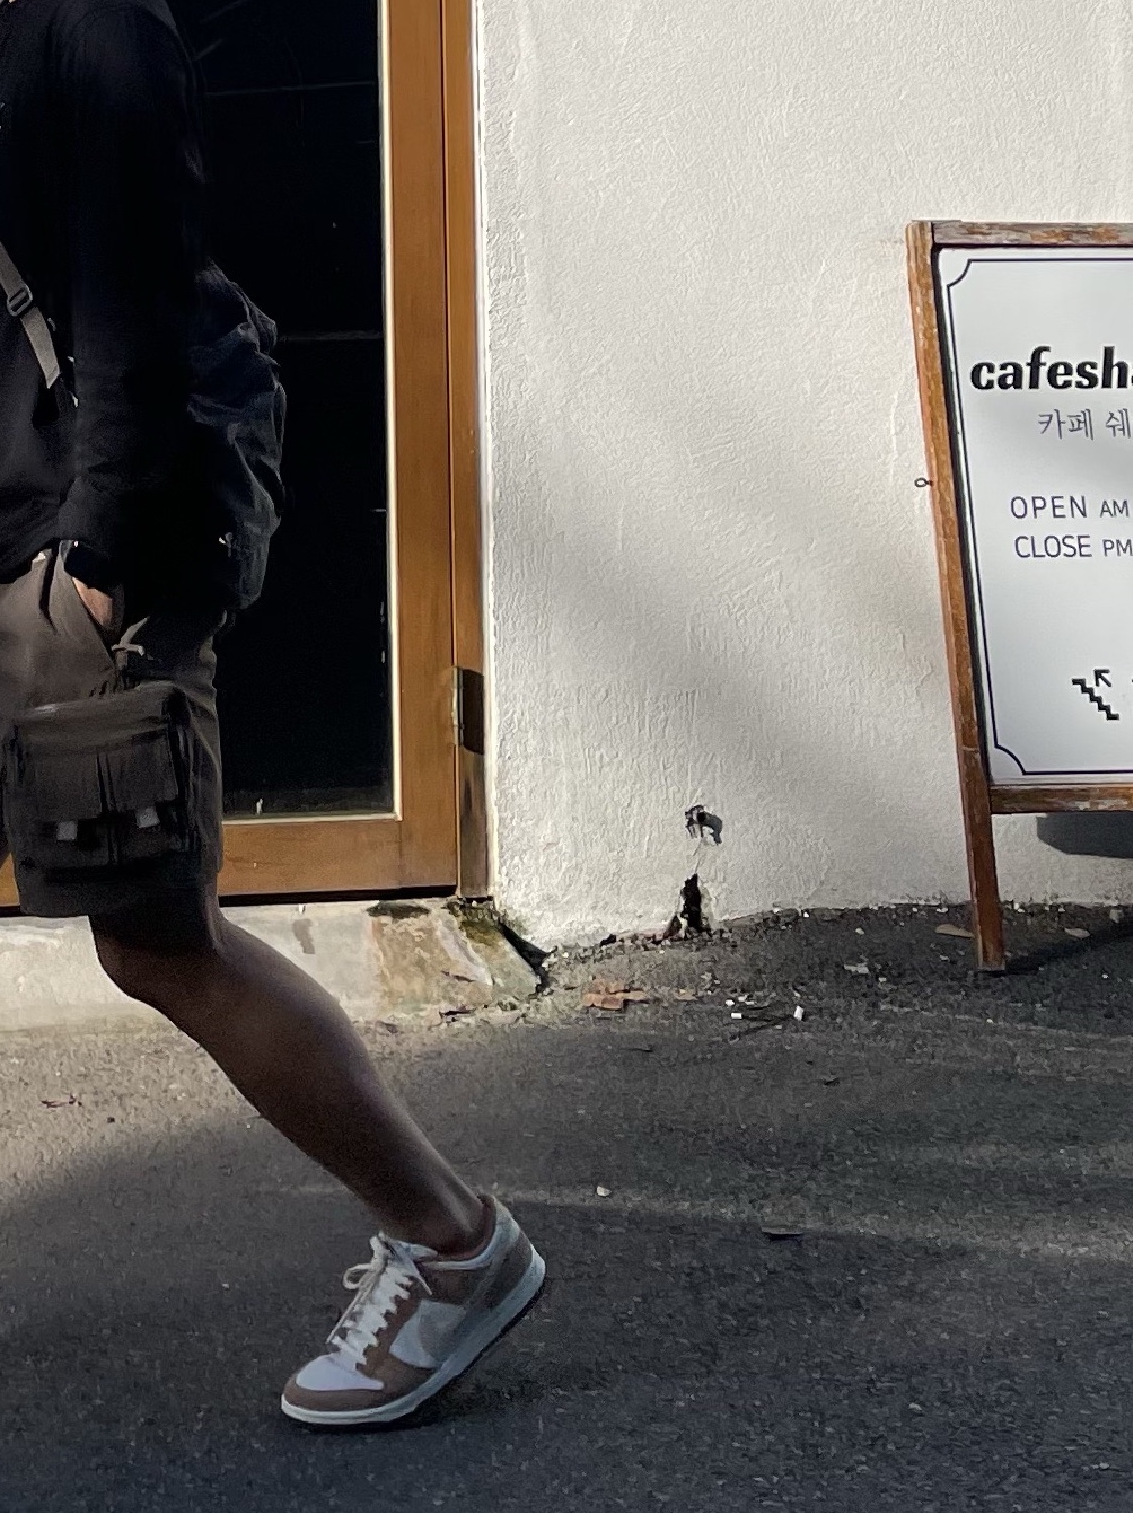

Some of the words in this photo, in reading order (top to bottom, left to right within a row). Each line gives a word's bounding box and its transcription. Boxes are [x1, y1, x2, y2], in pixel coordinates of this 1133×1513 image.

[971, 345, 1133, 390] cafesh
[1038, 408, 1093, 440] 카페
[1010, 495, 1088, 519] OPEN
[1099, 499, 1130, 518] AM
[1014, 534, 1093, 558] CLOSE
[1103, 538, 1133, 557] PM
